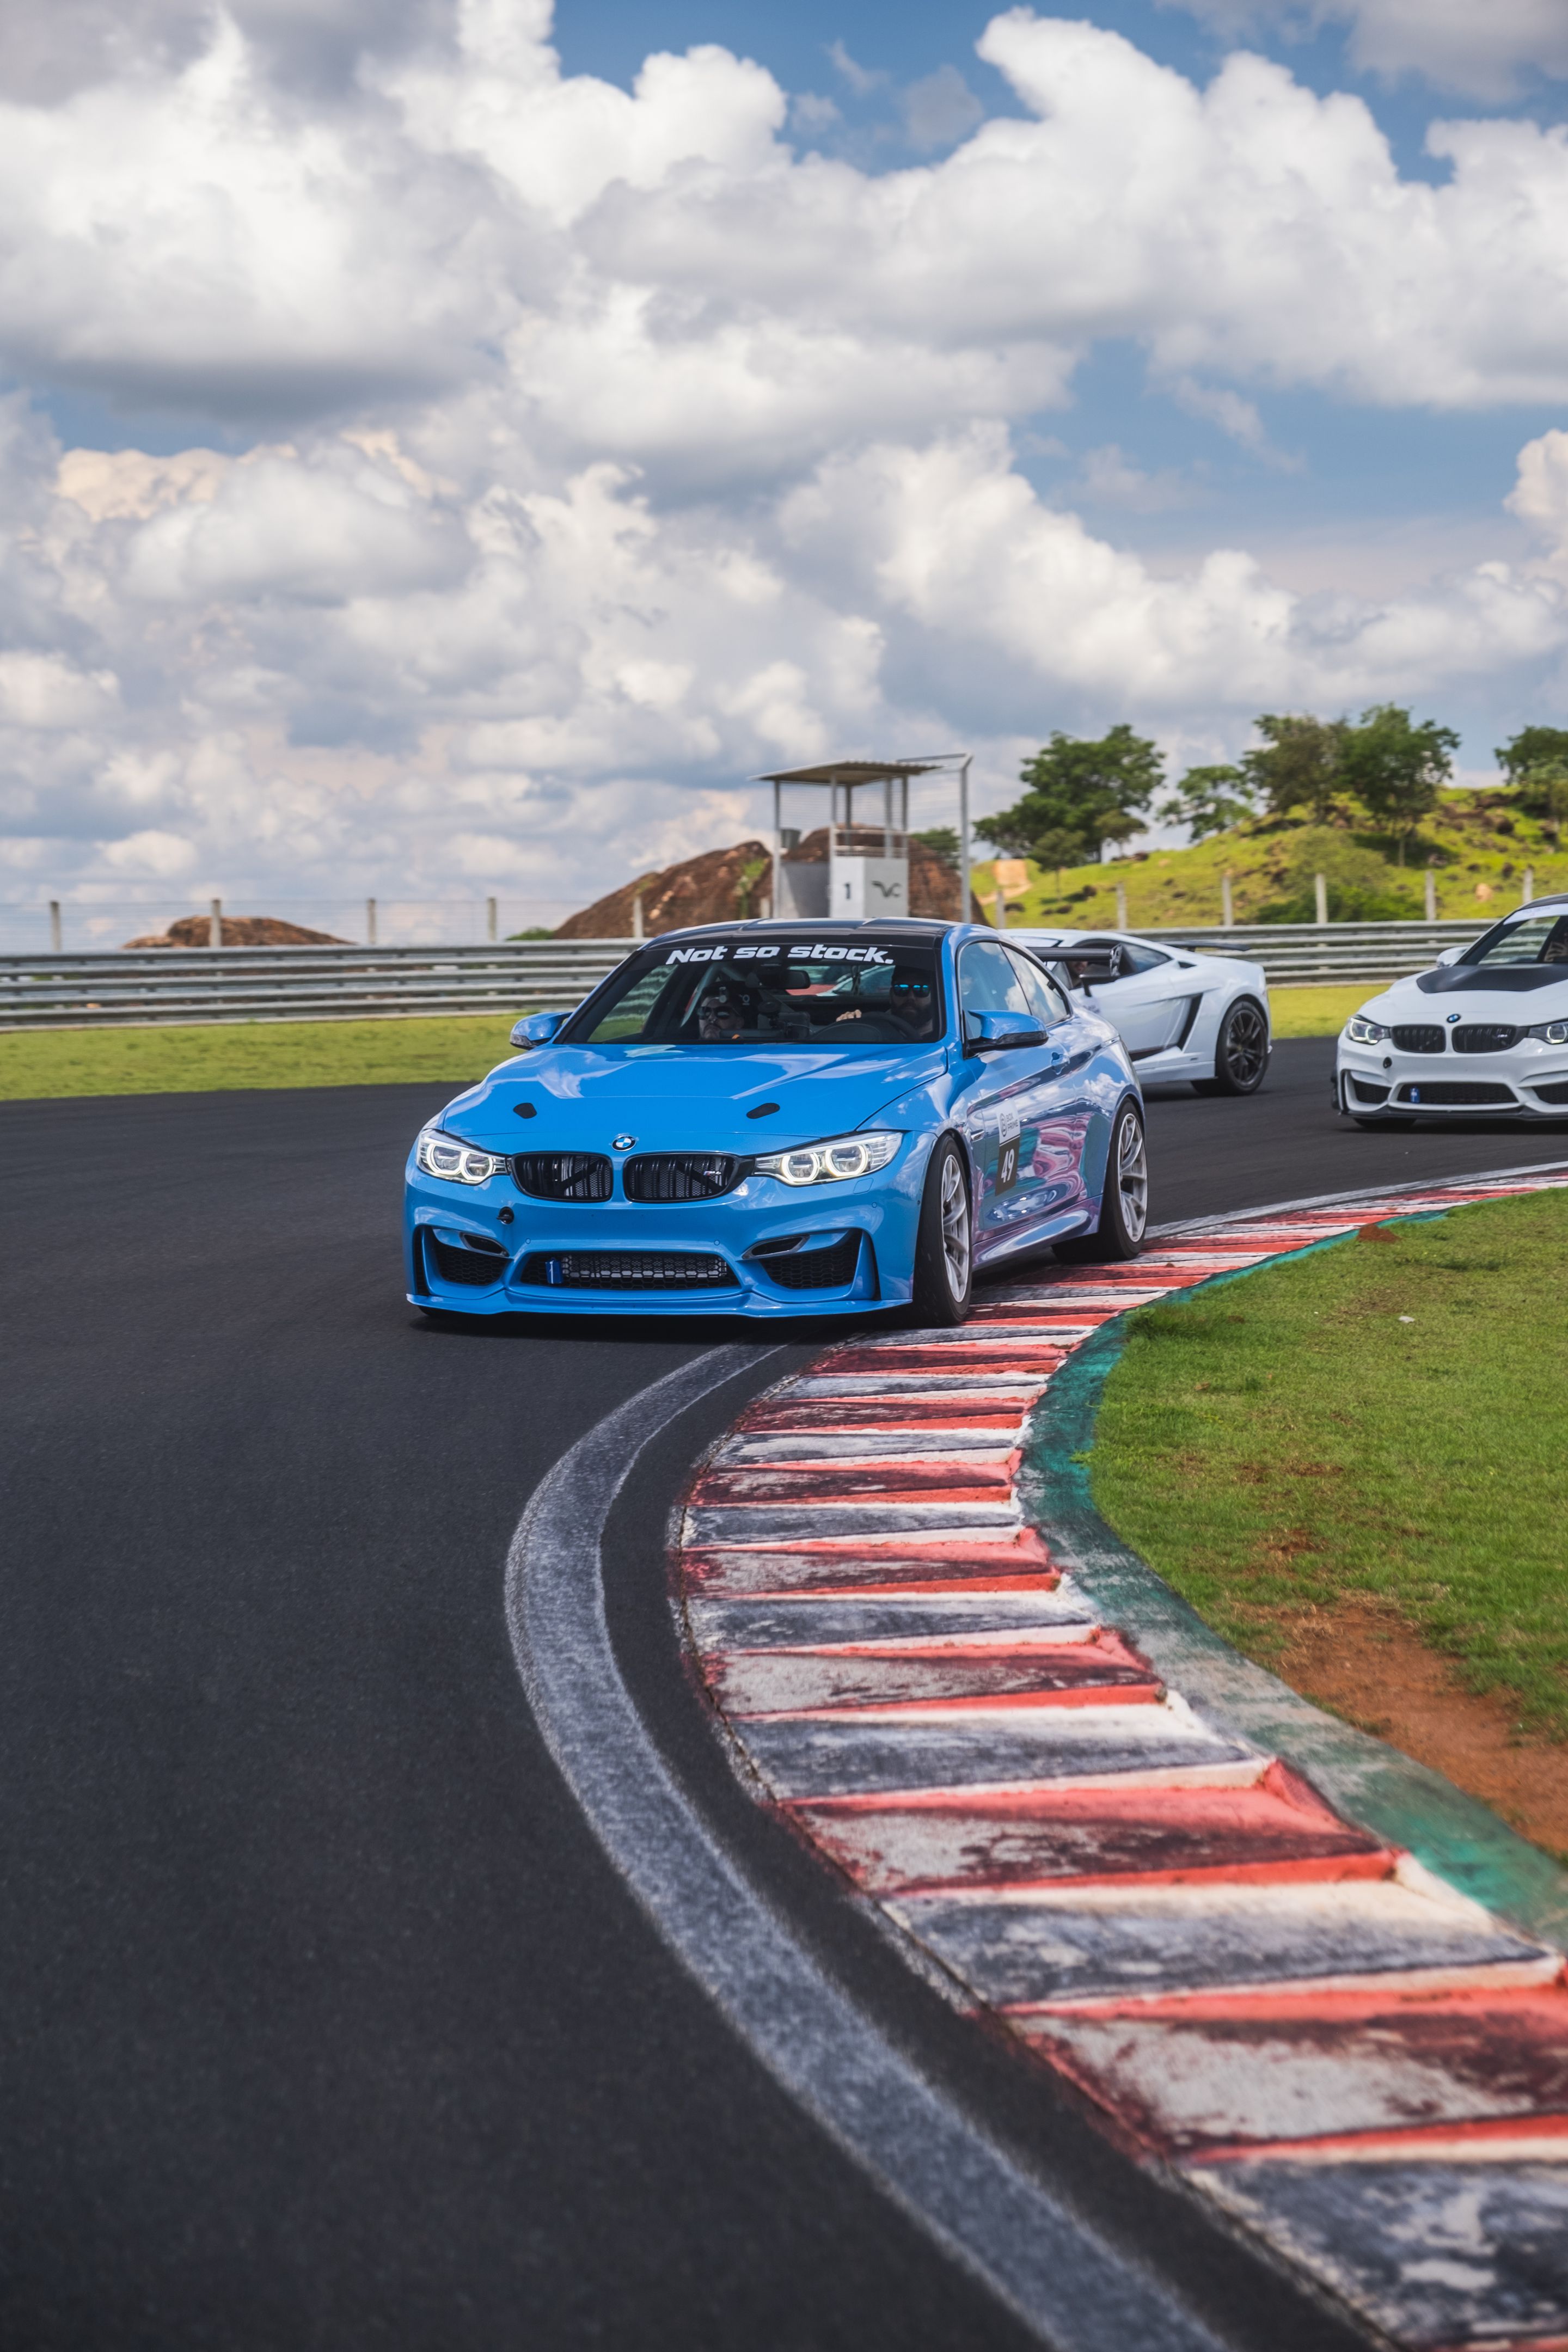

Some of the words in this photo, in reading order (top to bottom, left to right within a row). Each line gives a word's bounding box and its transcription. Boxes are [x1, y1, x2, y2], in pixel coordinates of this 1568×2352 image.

[844, 882, 852, 901] 1
[665, 946, 728, 965] Not
[733, 947, 780, 959] so
[787, 944, 894, 964] stock.
[1001, 1148, 1015, 1183] 49
